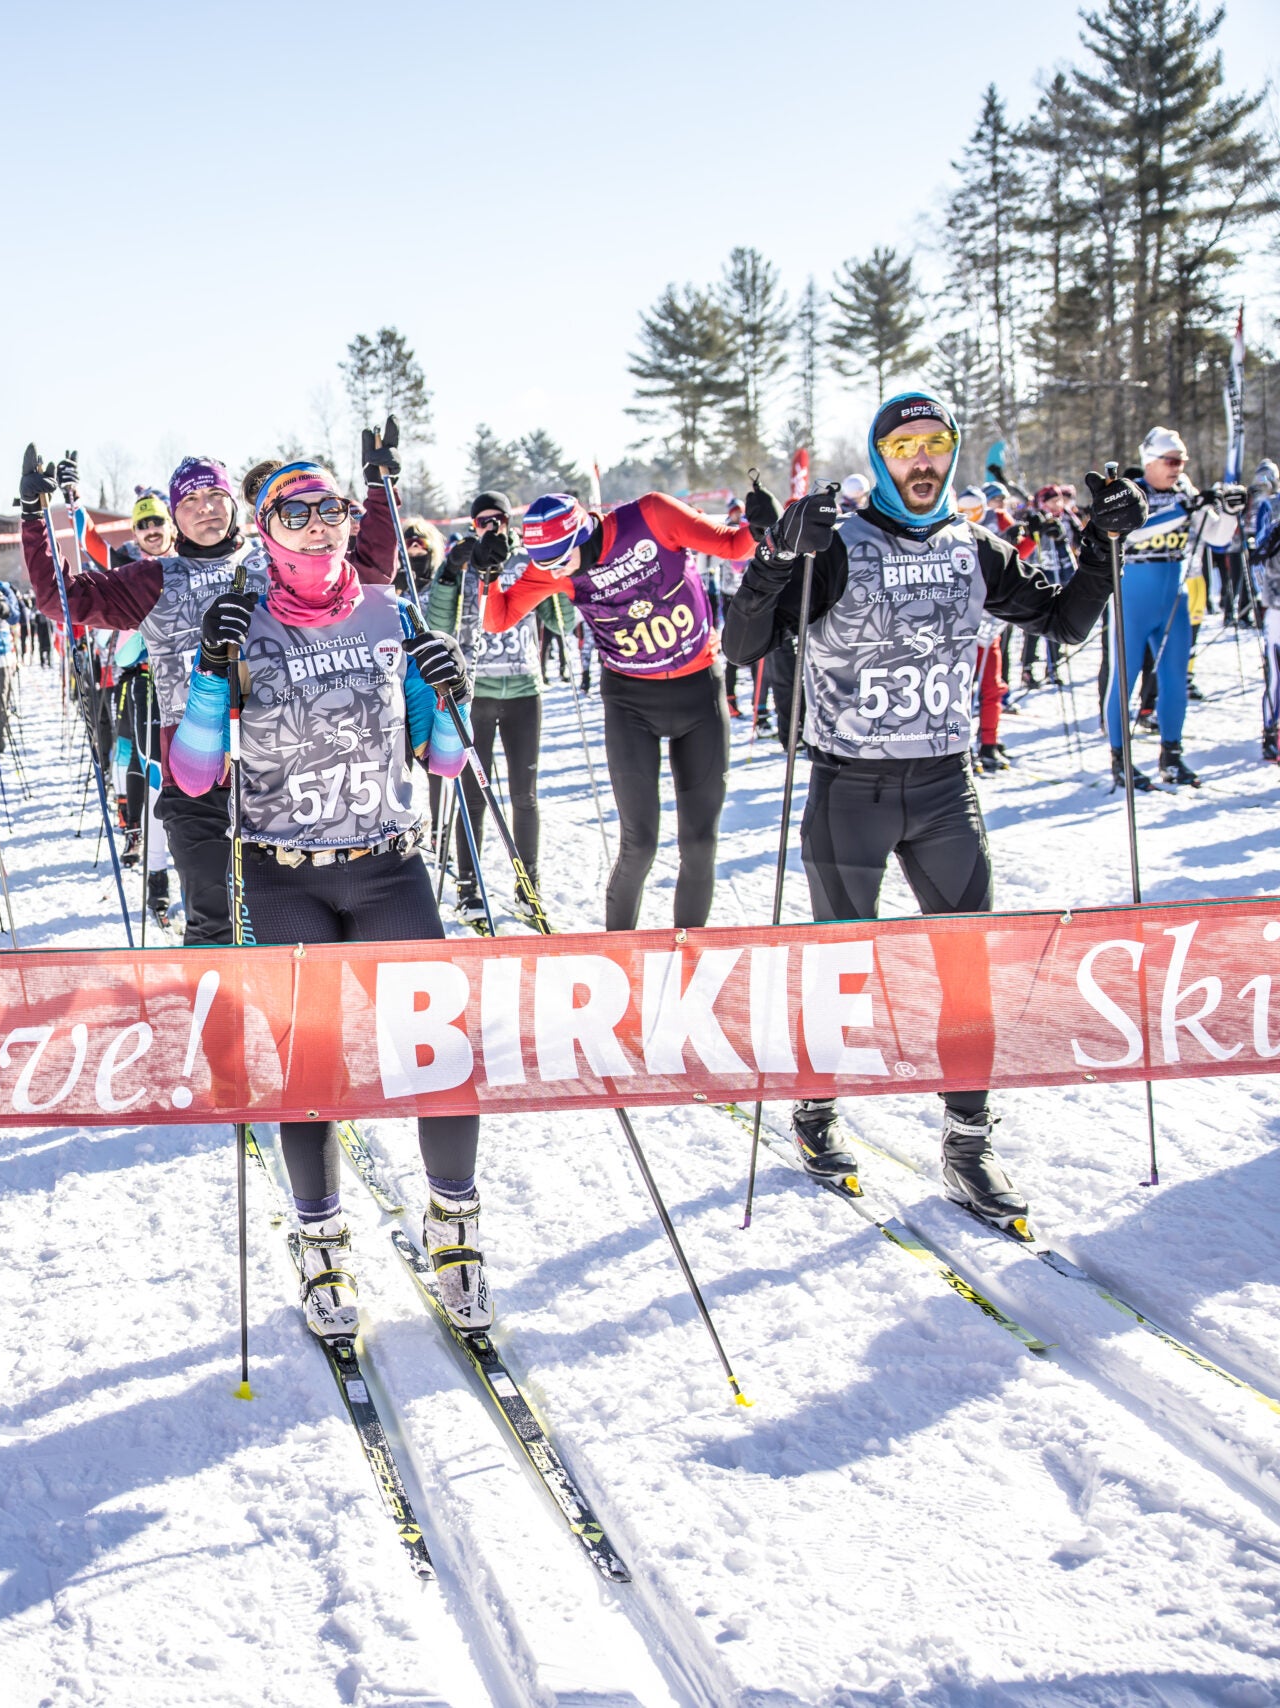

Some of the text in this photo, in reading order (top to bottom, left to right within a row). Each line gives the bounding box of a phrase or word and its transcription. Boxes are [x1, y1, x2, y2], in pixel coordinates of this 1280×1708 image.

[1104, 488, 1129, 504] CRAFT
[1134, 532, 1190, 550] 007
[641, 548, 653, 560] 27
[961, 559, 968, 571] 8
[190, 570, 235, 590] BIRK
[591, 558, 645, 590] BIRKIE
[604, 586, 622, 598] Run.
[622, 577, 641, 591] Bike.
[640, 561, 661, 580] Live!
[882, 563, 955, 588] BIRKIE
[178, 591, 195, 602] Ski.
[196, 588, 217, 599] Run.
[868, 586, 970, 604] Ski. Run. Bike. Live!
[614, 604, 695, 658] 5109
[285, 632, 367, 658] slumberland
[287, 646, 374, 683] BIRKIE
[386, 653, 394, 666] 3
[276, 686, 299, 704] Ski.
[301, 684, 332, 698] Run.
[335, 676, 365, 690] Bike.
[858, 661, 971, 721] 5363
[890, 732, 935, 742] Birkebeiner
[382, 819, 397, 828] US
[250, 833, 366, 846] 2022 American Birkebeiner
[375, 940, 890, 1100] BIRKIE
[477, 1267, 489, 1314] FISC
[369, 1446, 406, 1519] FISCHER
